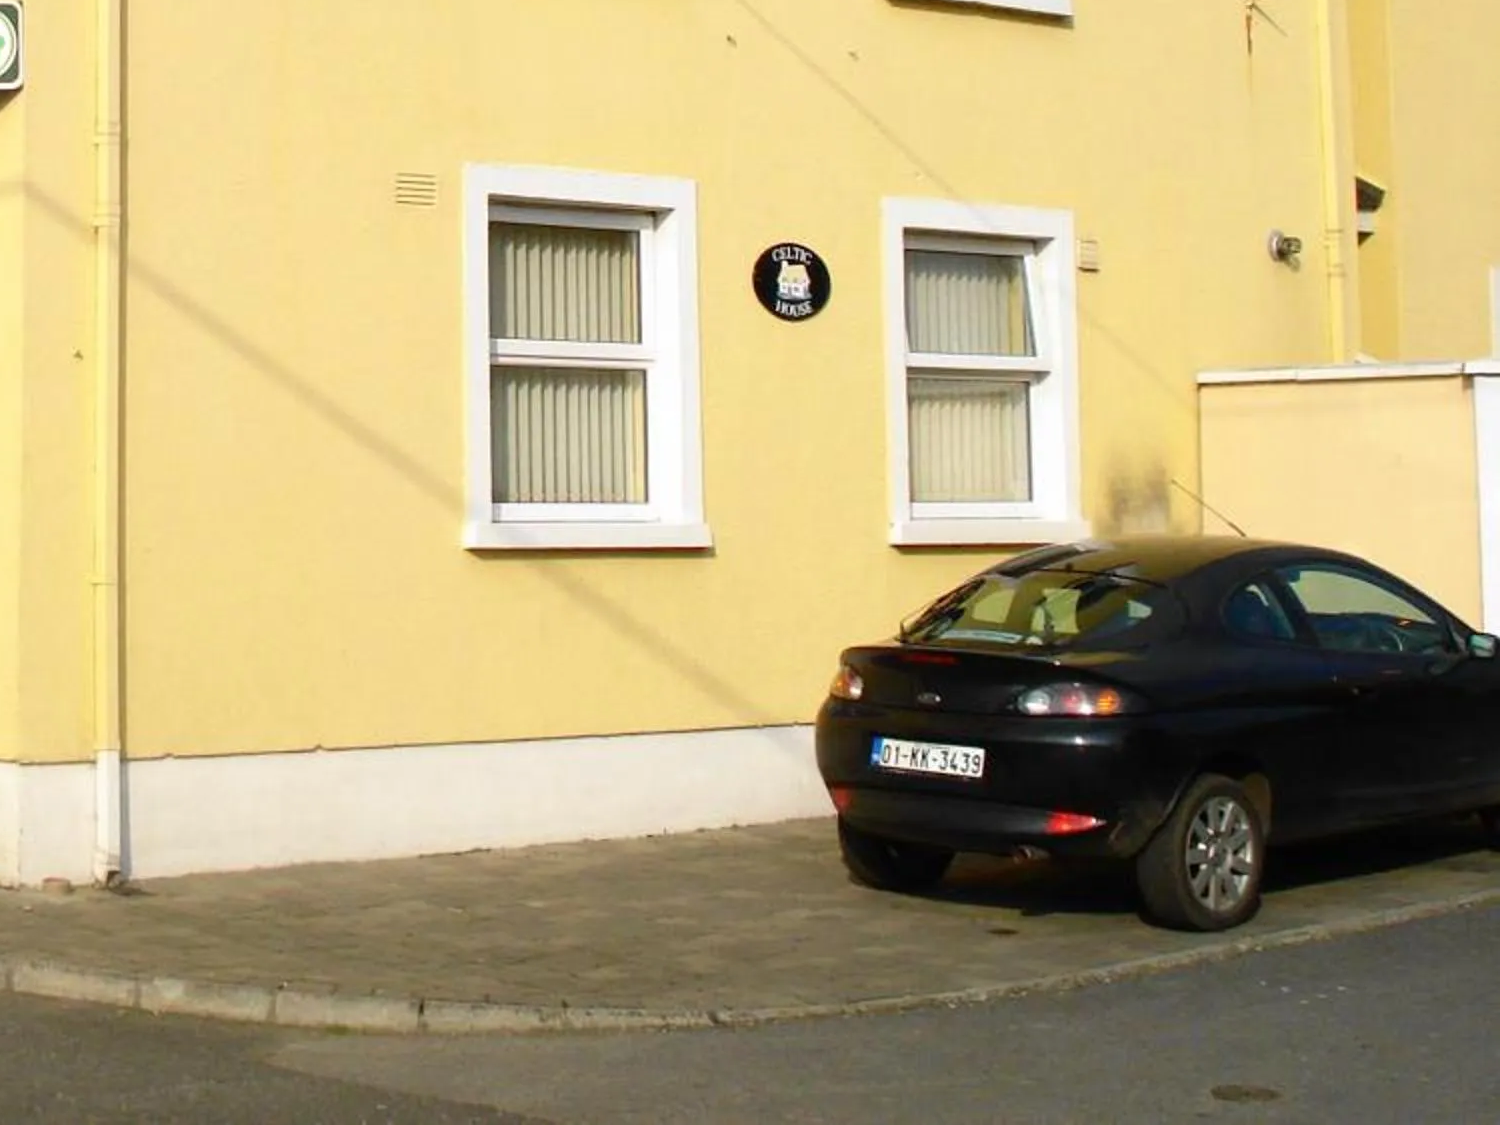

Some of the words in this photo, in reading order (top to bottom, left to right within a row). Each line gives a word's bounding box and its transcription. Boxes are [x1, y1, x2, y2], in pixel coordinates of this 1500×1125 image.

[771, 246, 813, 265] CELTIC
[775, 299, 814, 317] HOUSE
[881, 743, 982, 774] 01-KK-3439
